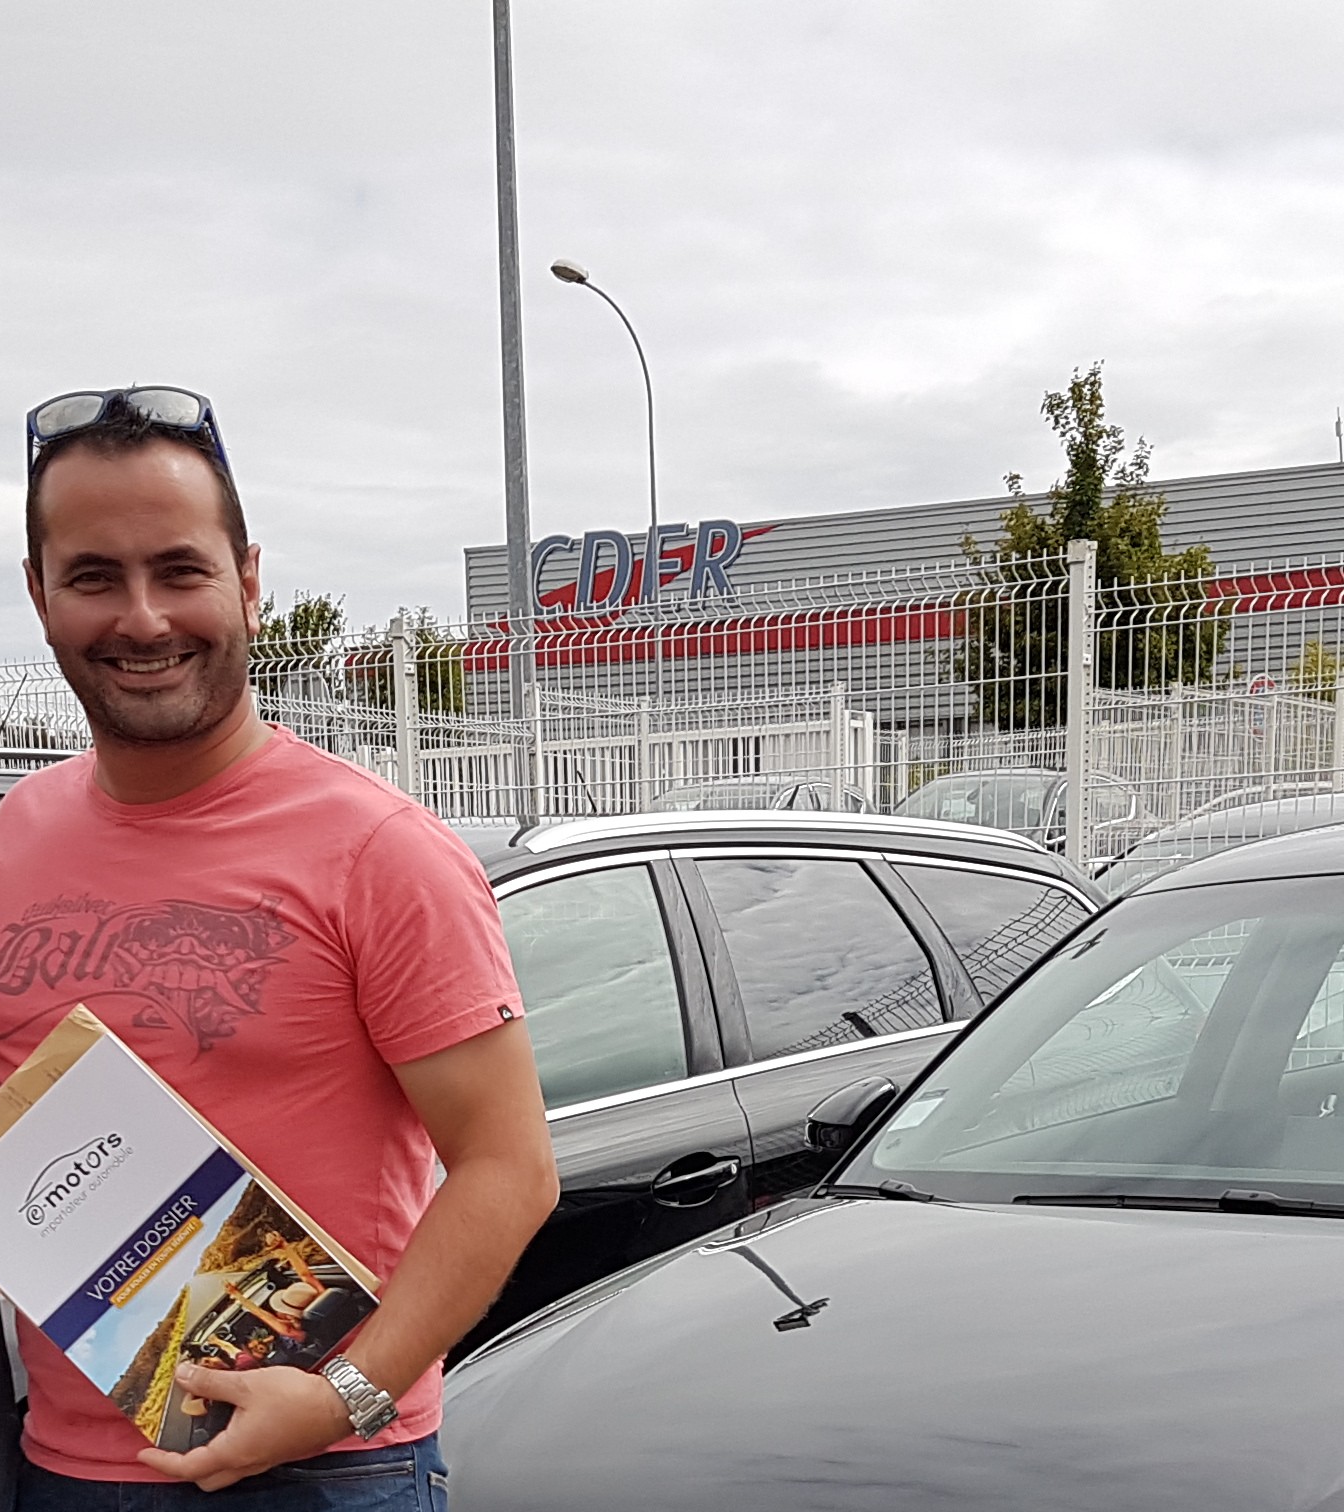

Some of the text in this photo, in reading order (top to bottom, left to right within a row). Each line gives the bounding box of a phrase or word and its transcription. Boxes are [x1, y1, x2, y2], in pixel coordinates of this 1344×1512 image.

[531, 520, 742, 617] CDER
[86, 1194, 198, 1301] VOTRE DOSSIER
